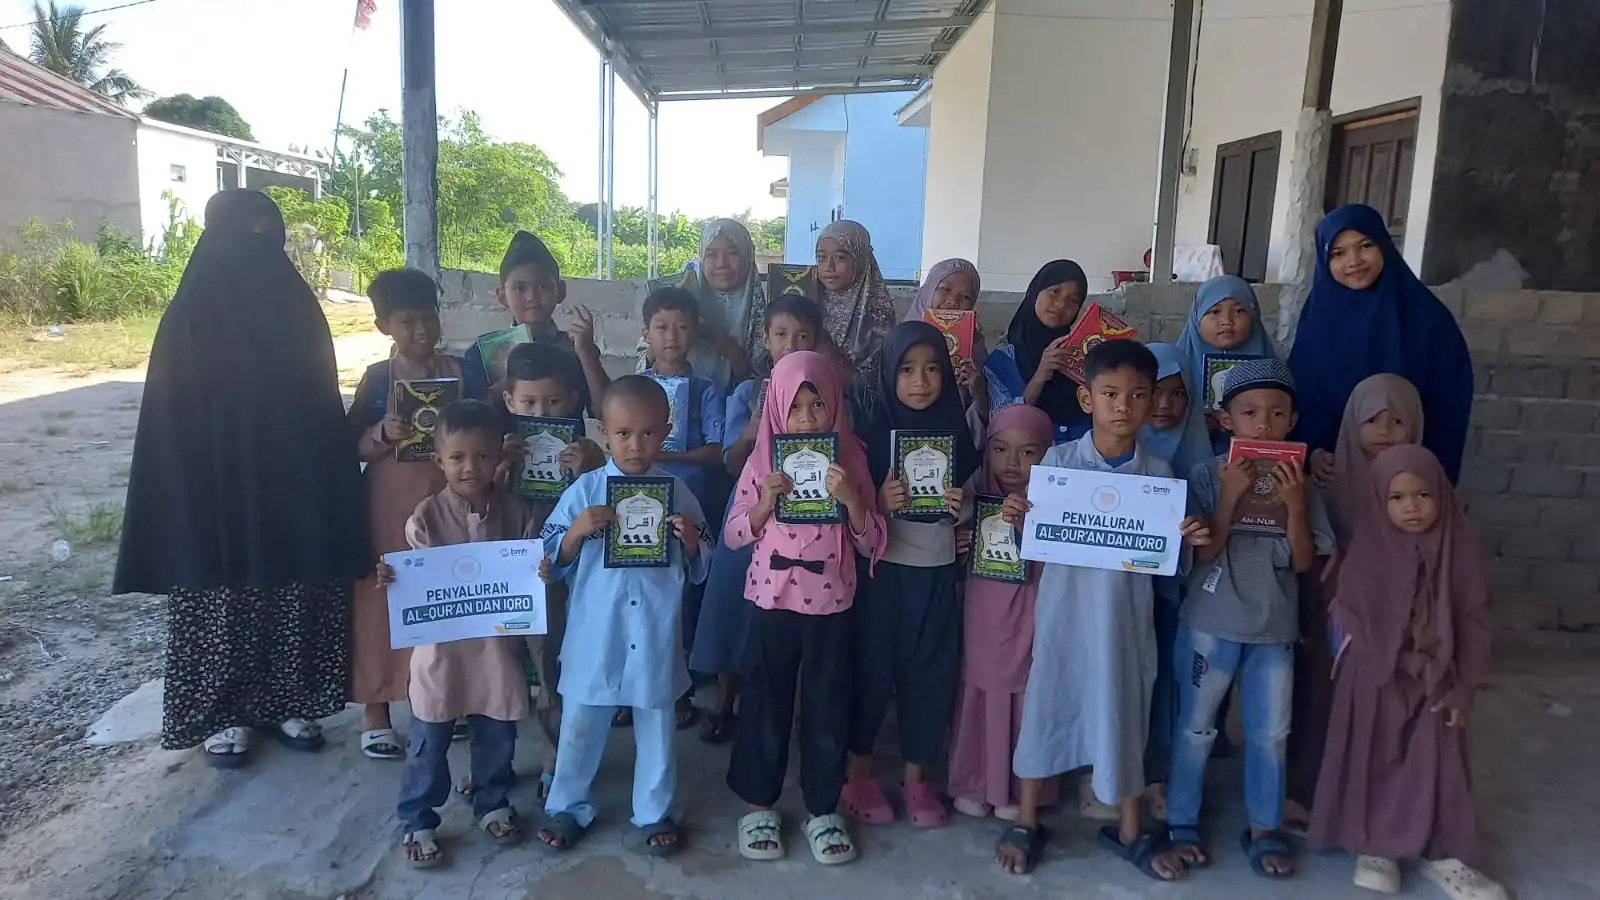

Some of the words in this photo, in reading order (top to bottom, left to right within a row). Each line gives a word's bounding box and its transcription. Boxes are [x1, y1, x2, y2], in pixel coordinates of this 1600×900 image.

[1062, 511, 1145, 531] PENYALURAN
[1038, 526, 1105, 545] AL-QUR'AN
[1107, 534, 1132, 548] DAN
[1135, 537, 1164, 551] IQRO
[426, 581, 509, 602] PENYALURAN
[406, 603, 473, 623] AL-QUR'AN
[475, 599, 501, 613] DAN
[503, 597, 530, 611] IQRO
